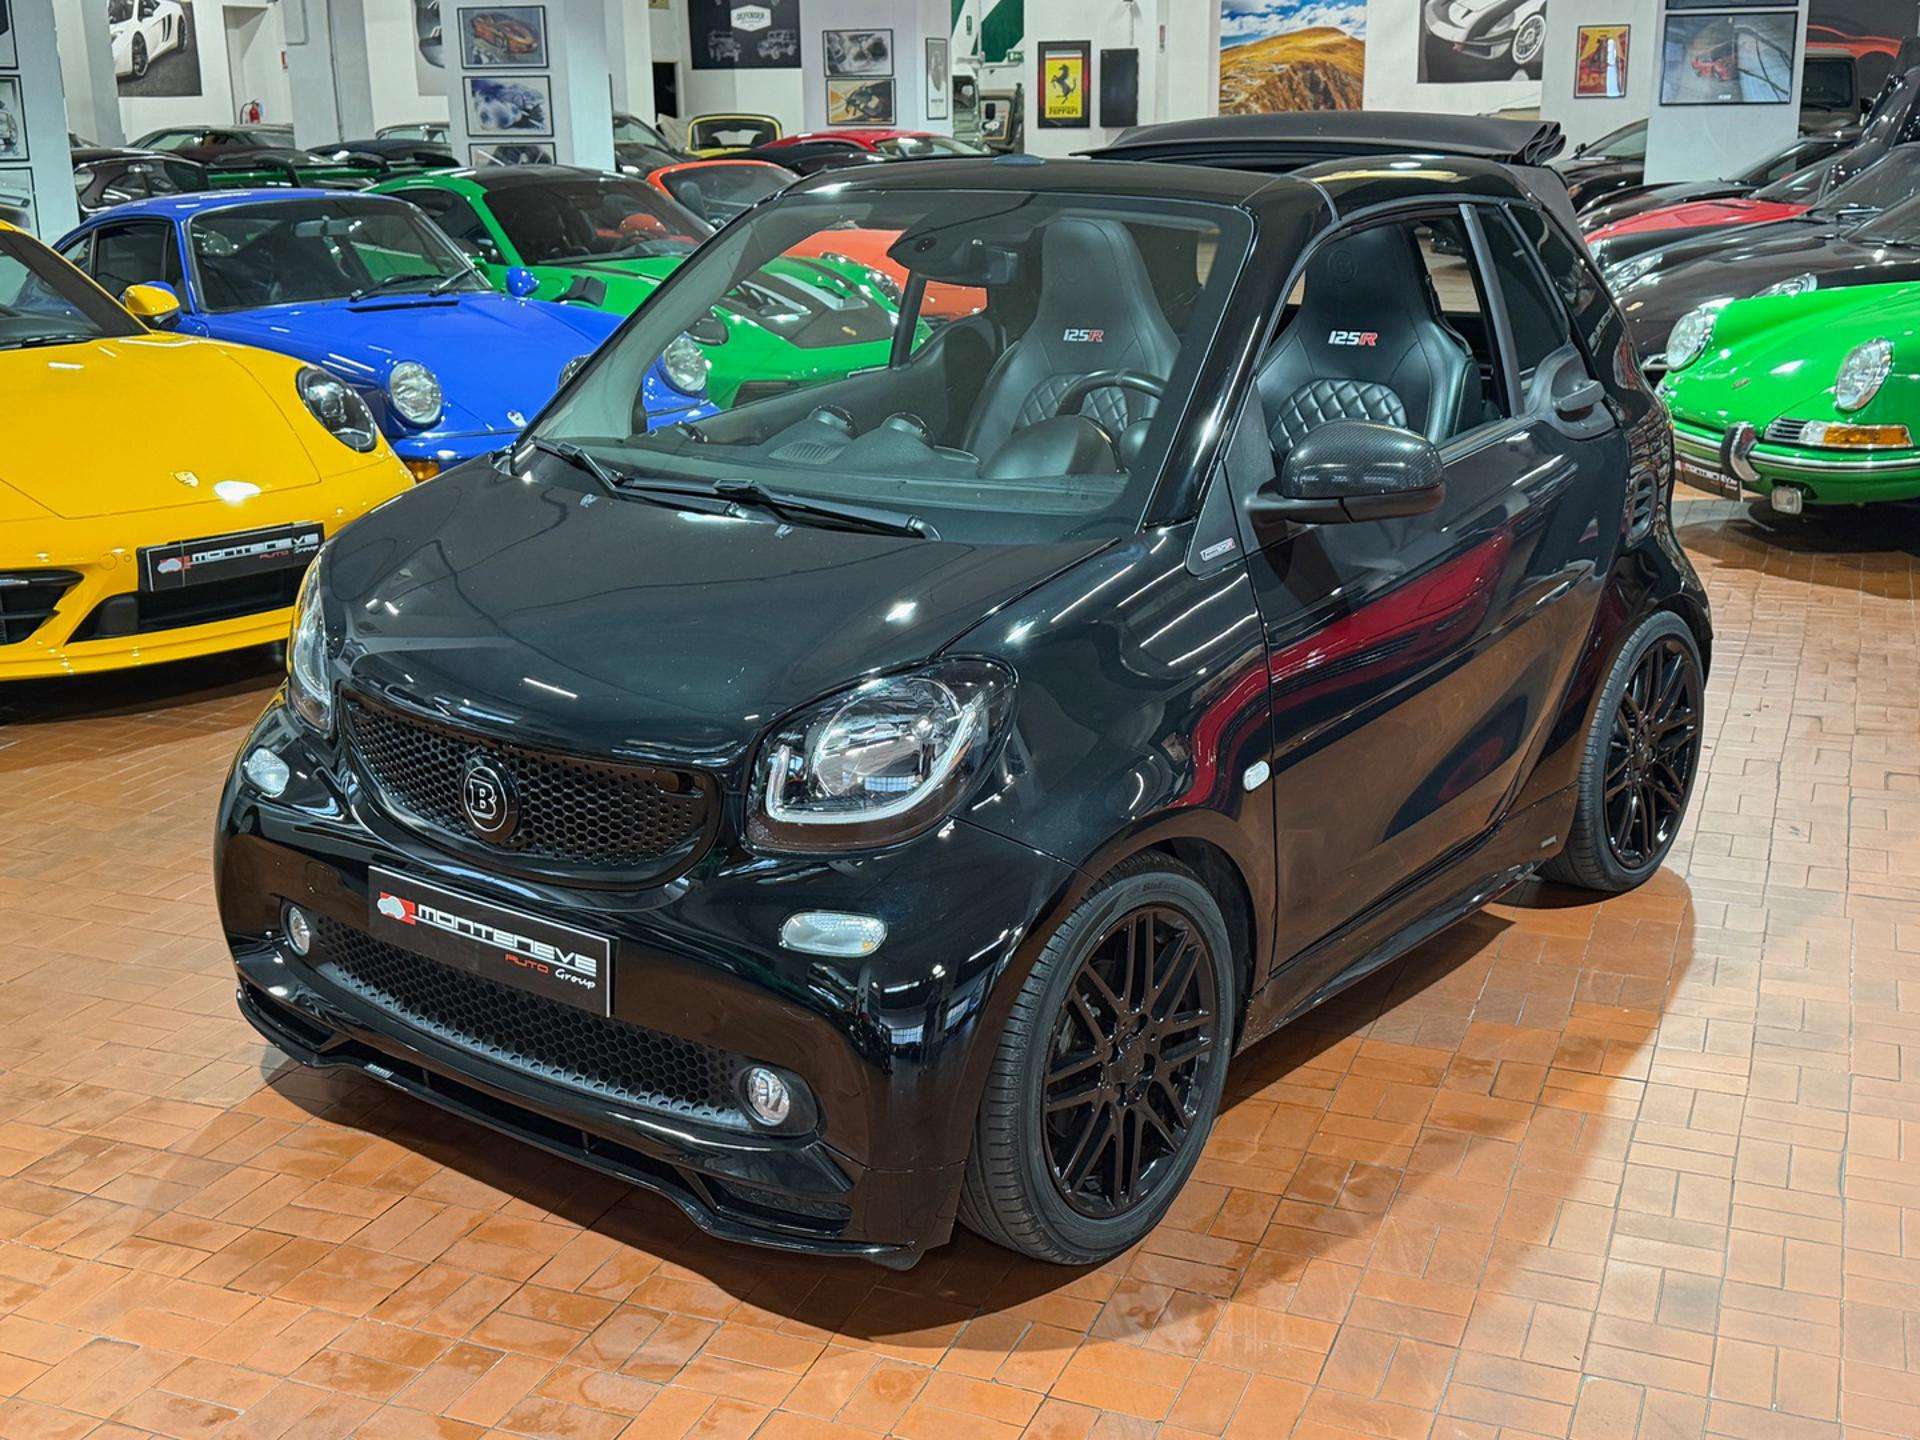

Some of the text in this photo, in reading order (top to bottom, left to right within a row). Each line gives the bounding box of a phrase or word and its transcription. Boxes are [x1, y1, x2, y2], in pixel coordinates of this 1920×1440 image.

[1063, 329, 1104, 342] 125R
[1328, 331, 1377, 346] 125R
[418, 903, 597, 970] MONTENEVE
[505, 953, 597, 990] AUTO Group
